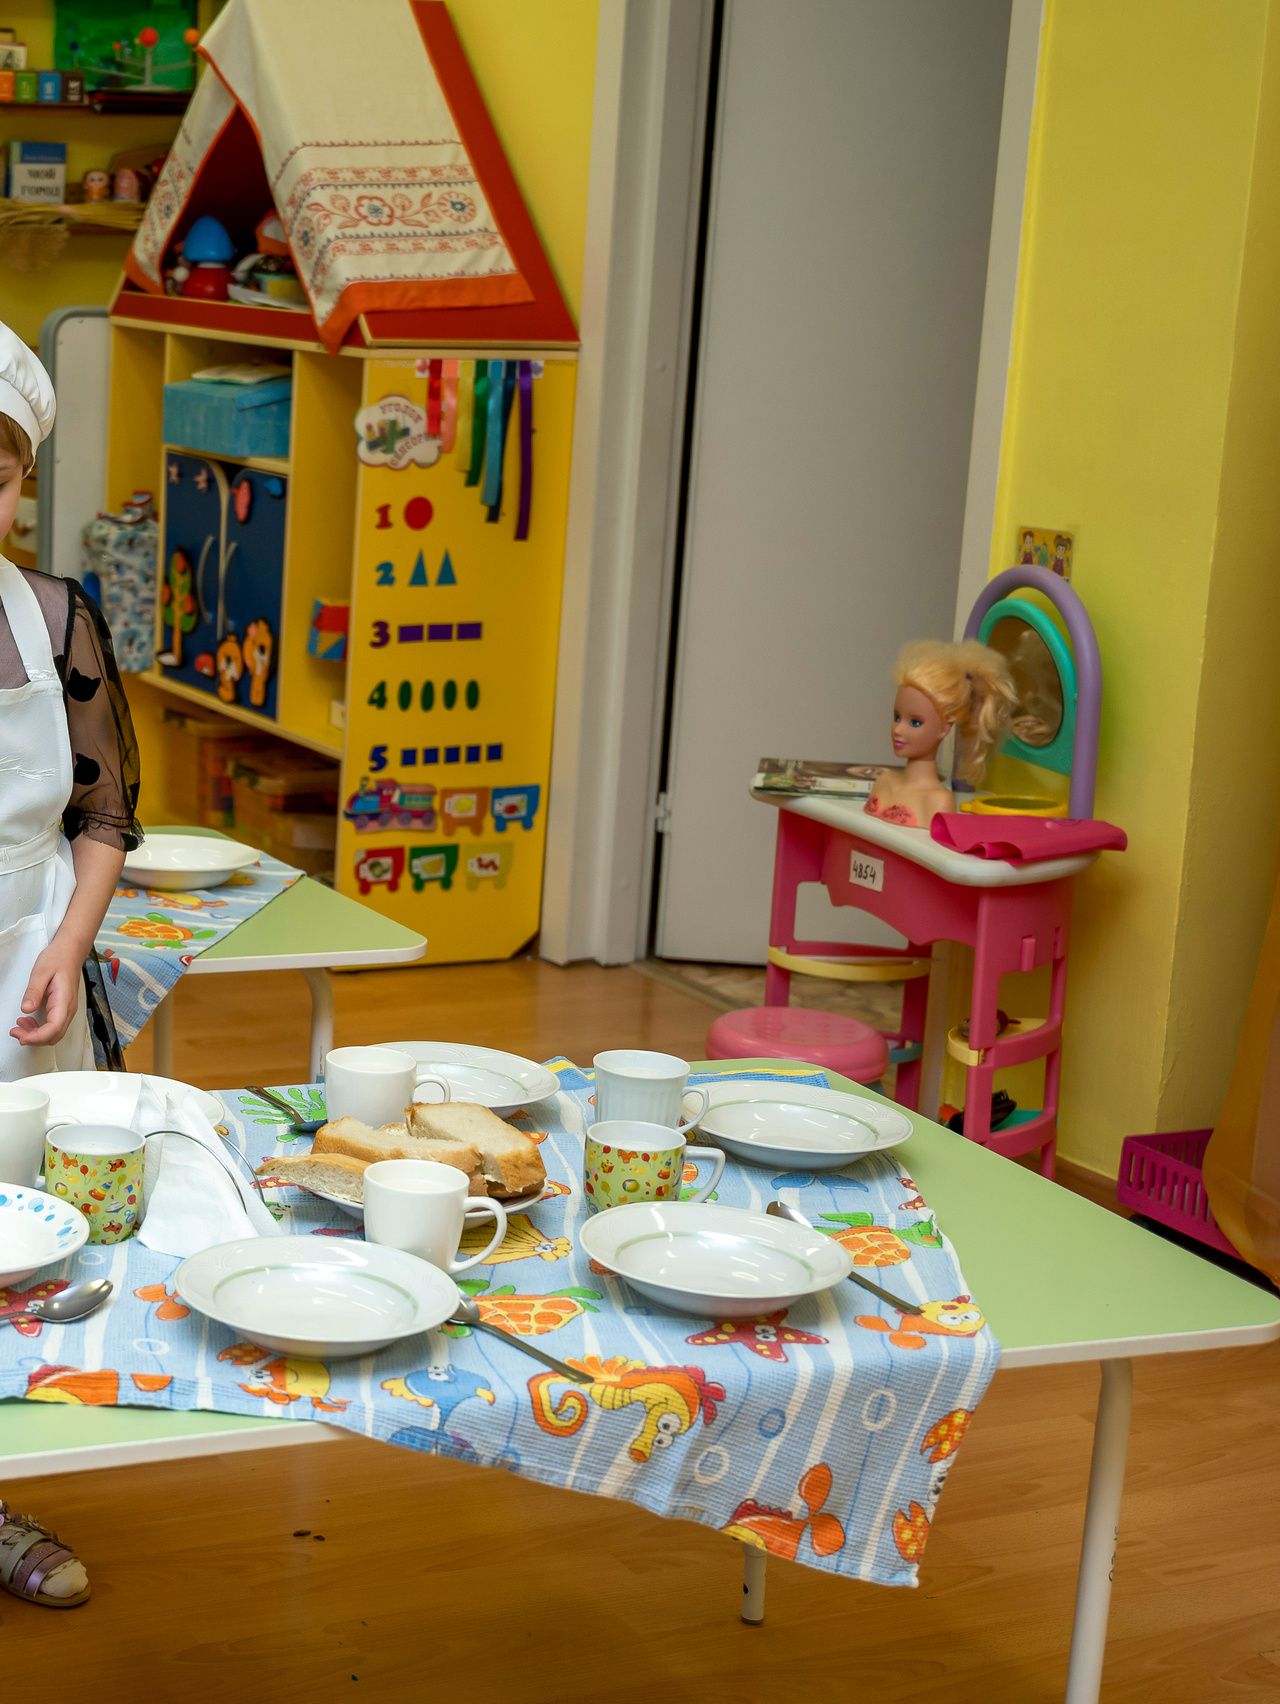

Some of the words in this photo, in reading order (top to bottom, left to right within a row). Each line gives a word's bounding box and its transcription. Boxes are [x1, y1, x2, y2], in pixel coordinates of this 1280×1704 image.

[374, 503, 393, 529] 1
[375, 561, 396, 587] 2
[369, 620, 391, 648] 3
[367, 680, 388, 710] 4
[369, 744, 388, 772] 5
[853, 860, 876, 884] 4854
